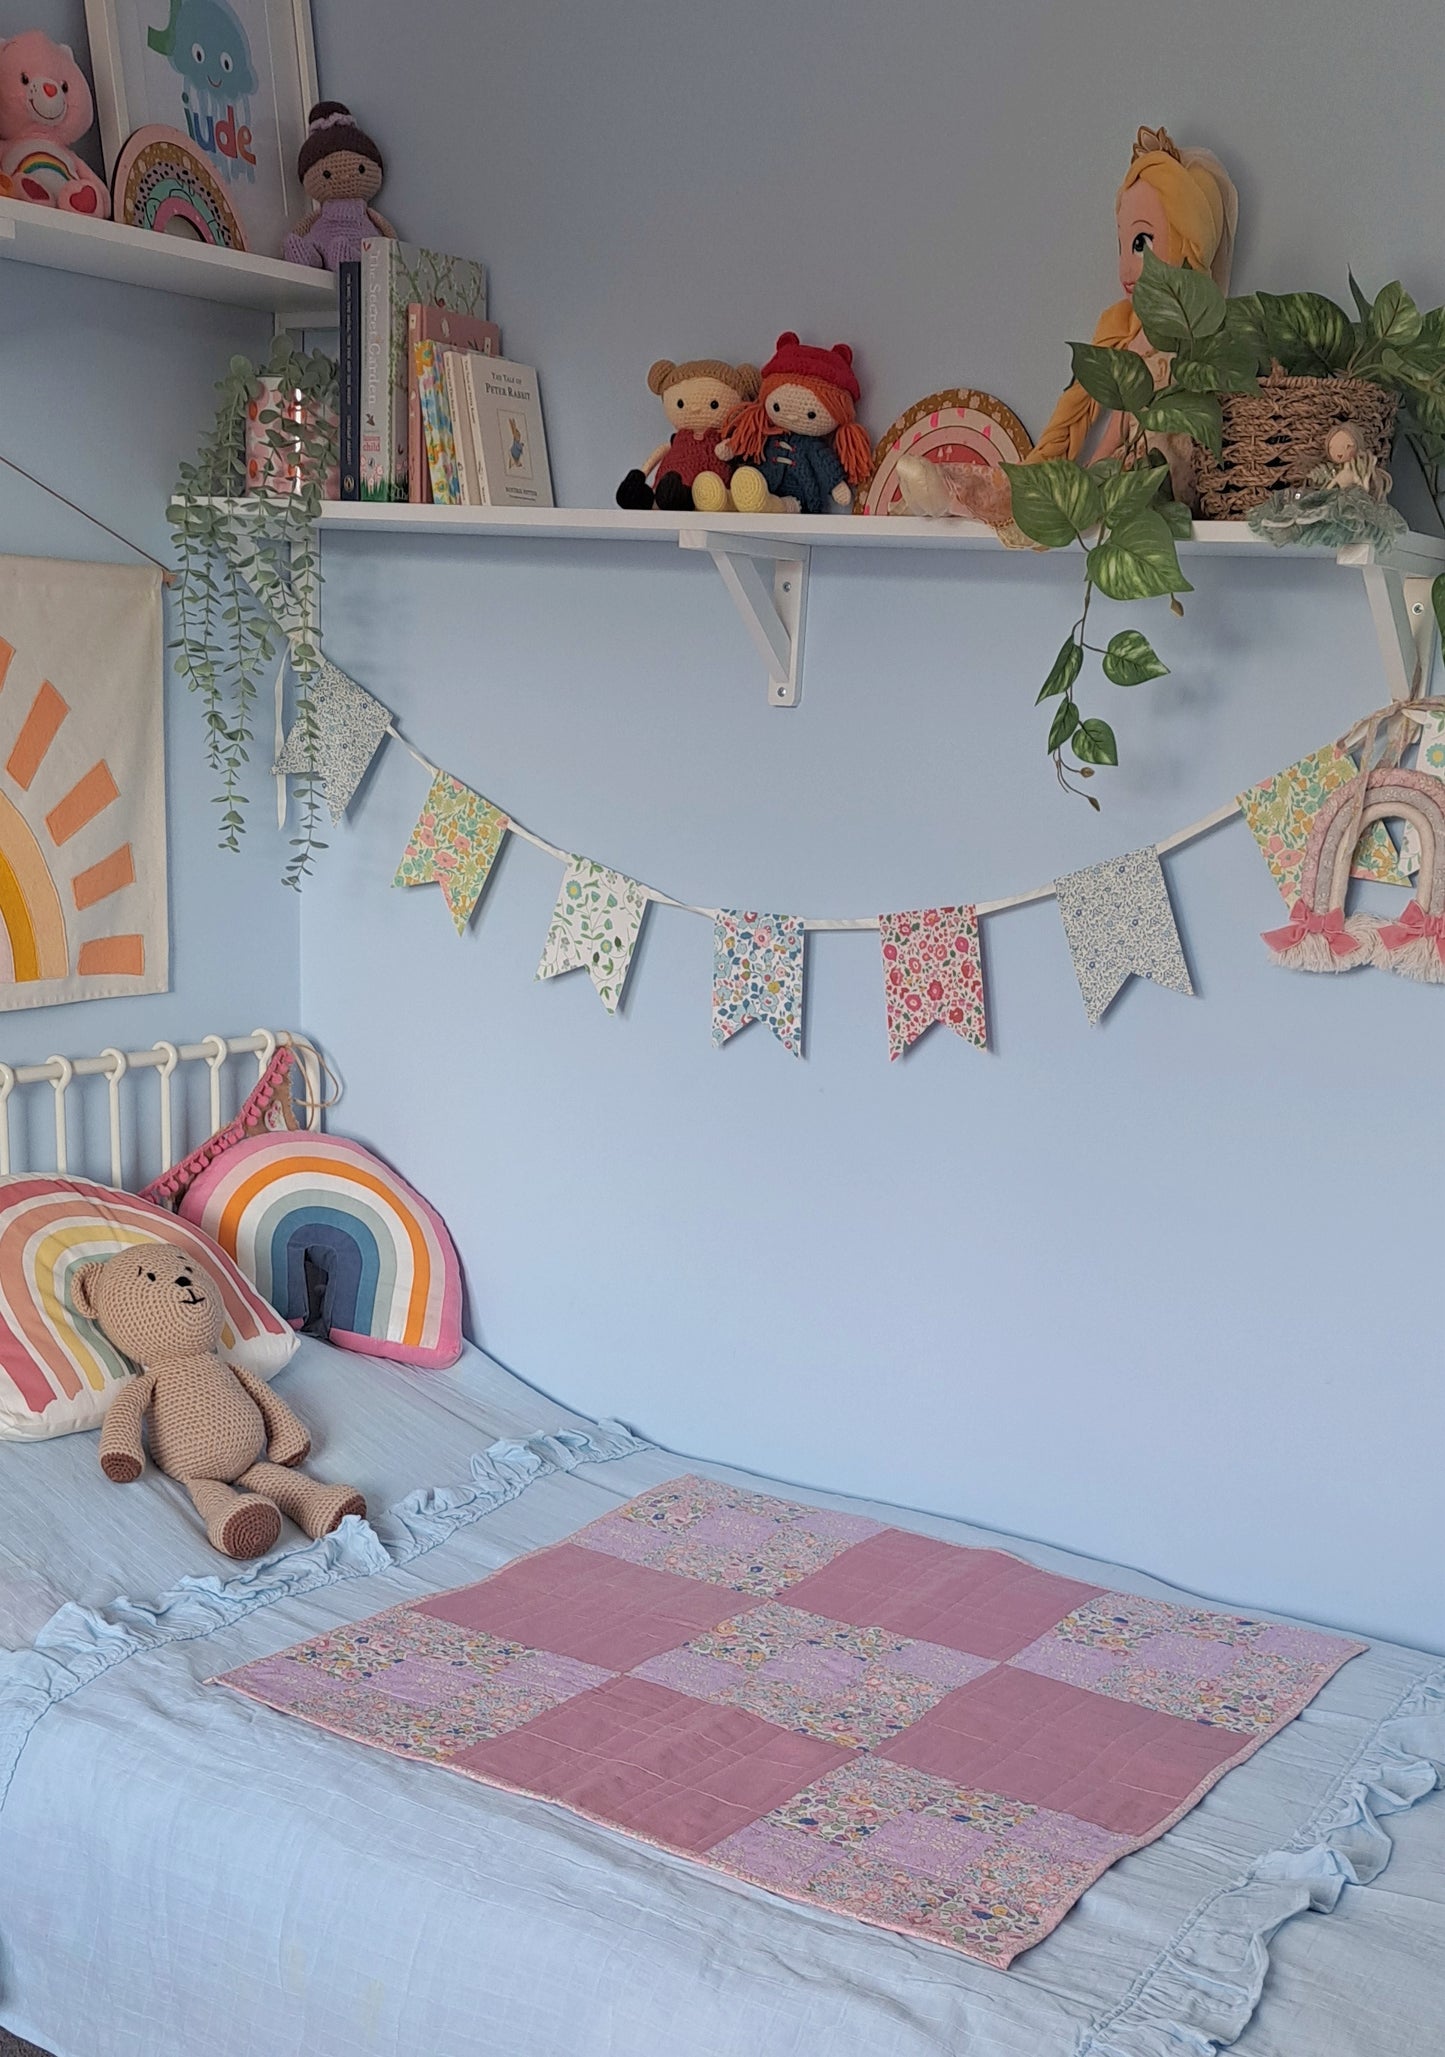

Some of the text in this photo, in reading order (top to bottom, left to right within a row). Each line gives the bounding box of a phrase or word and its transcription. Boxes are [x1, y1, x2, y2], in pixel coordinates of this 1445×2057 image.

[368, 250, 381, 404] The Secret Garden
[485, 382, 507, 396] PETER
